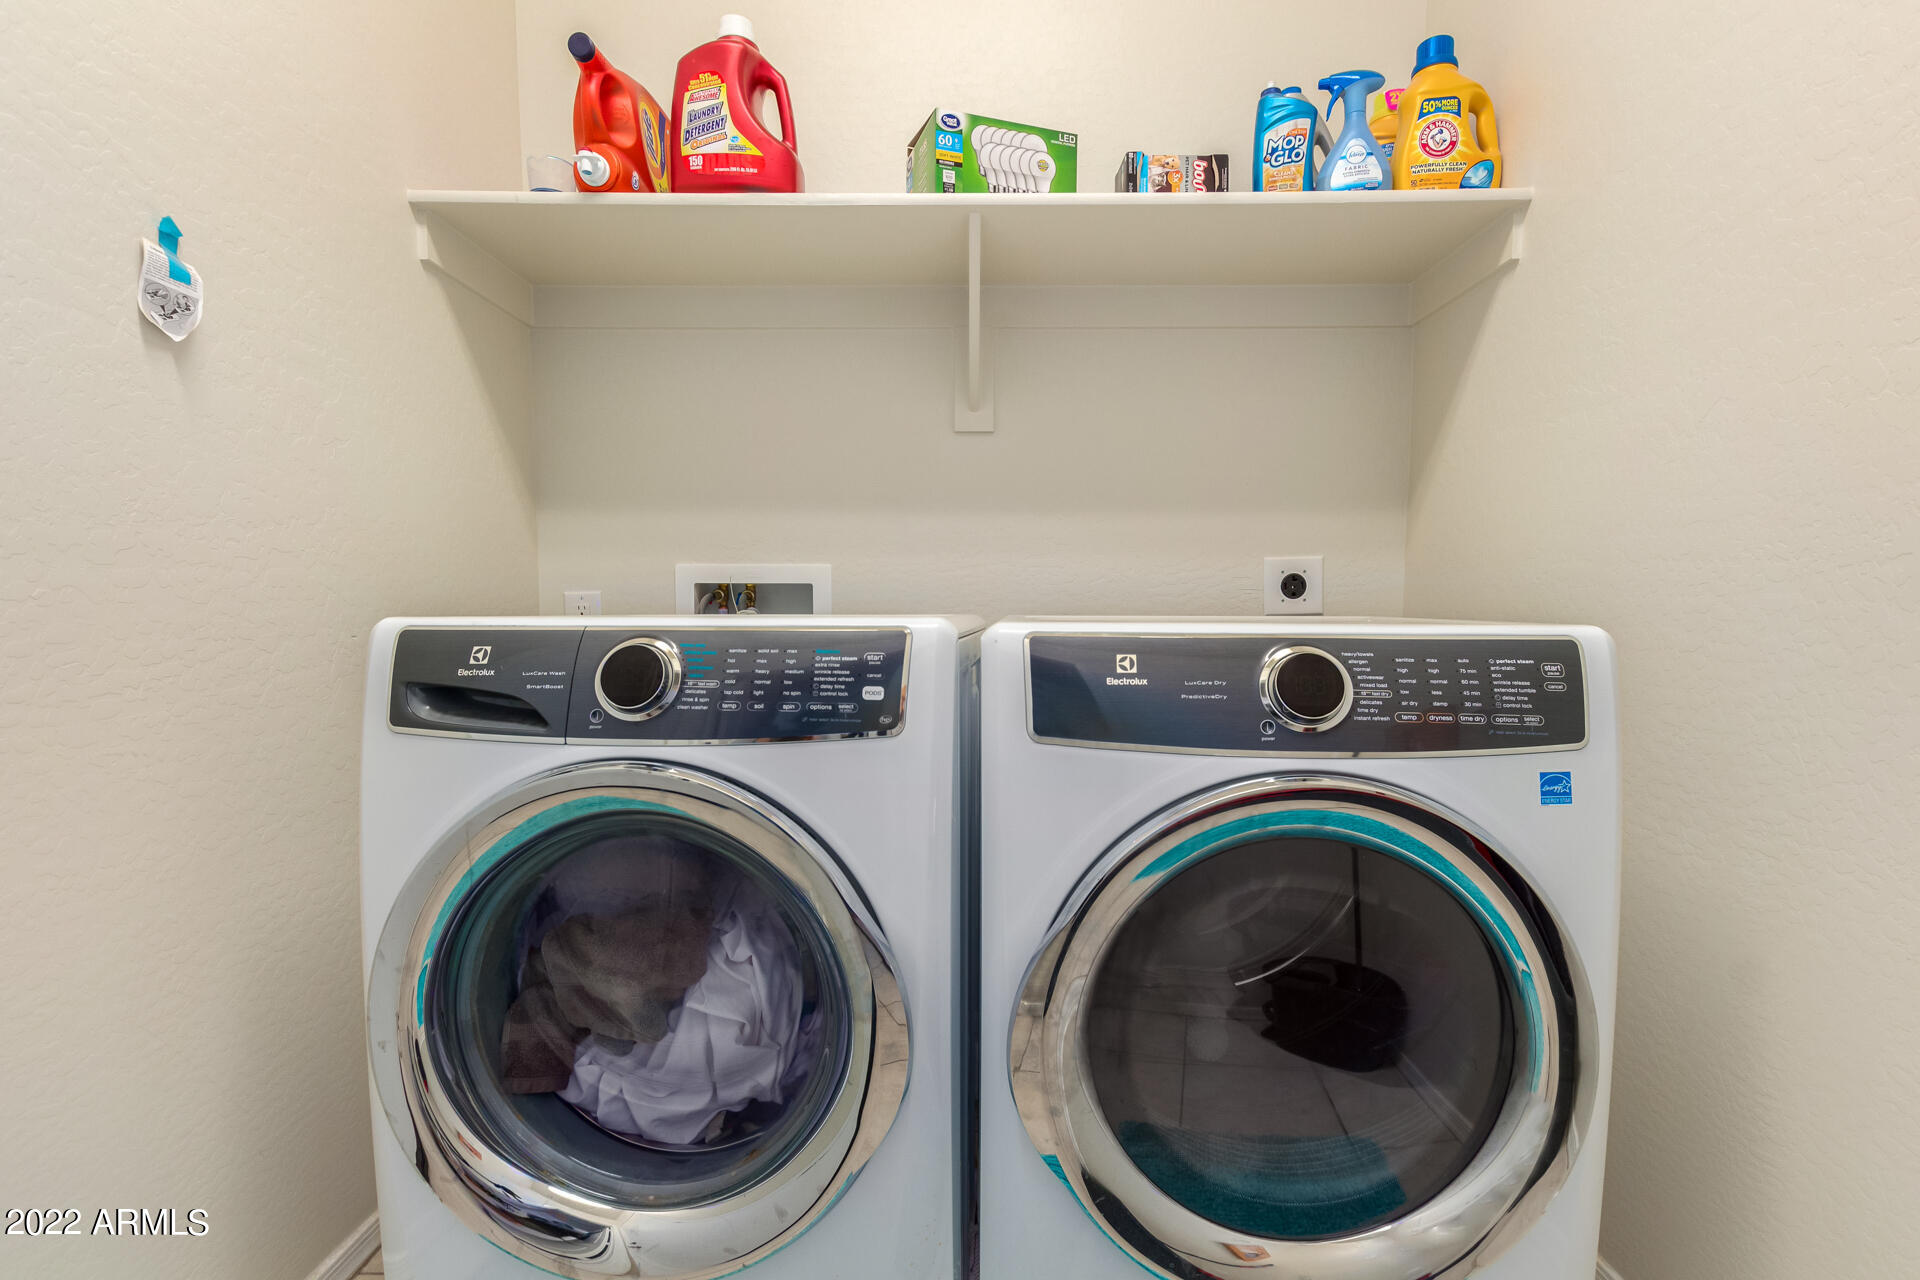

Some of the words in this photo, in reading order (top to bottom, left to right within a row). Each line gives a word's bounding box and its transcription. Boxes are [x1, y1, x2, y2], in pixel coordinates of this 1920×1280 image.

[1422, 101, 1442, 113] 50%
[688, 104, 721, 123] LAUNDRY
[685, 117, 725, 142] DETERGENT
[1421, 127, 1431, 144] ARM
[1429, 123, 1436, 131] &
[1435, 120, 1457, 142] HAMMER
[690, 132, 727, 150] ORIGINAL
[938, 134, 953, 146] 60
[1058, 132, 1076, 144] LED
[1267, 135, 1305, 154] MOP
[688, 155, 703, 166] 150
[1270, 148, 1304, 167] GLO
[1410, 162, 1448, 171] POWERFULLY
[1412, 167, 1445, 175] NATURALLY
[457, 668, 496, 676] Electrolux
[1106, 677, 1148, 686] Electrolux
[1474, 715, 1485, 723] dry
